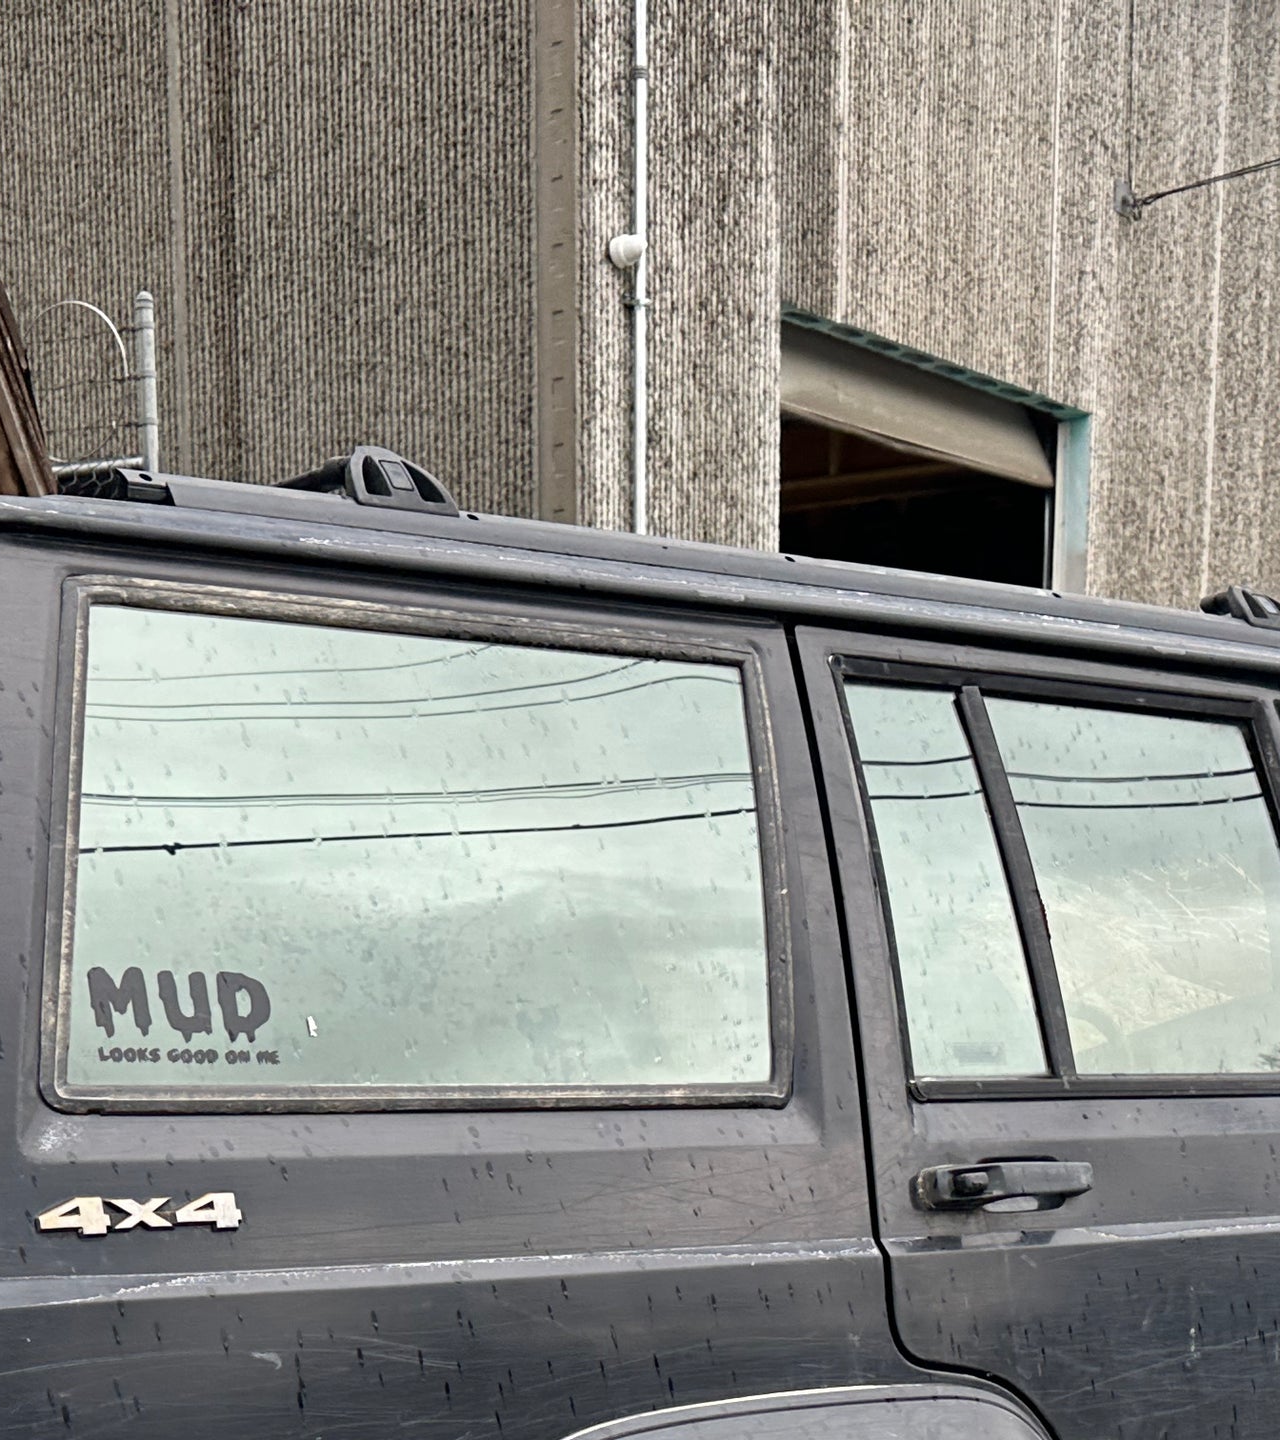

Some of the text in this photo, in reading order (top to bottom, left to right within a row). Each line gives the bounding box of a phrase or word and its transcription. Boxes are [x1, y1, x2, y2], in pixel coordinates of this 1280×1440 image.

[87, 966, 271, 1043] MUD
[98, 1047, 281, 1065] LOOKS GOOD ON ME
